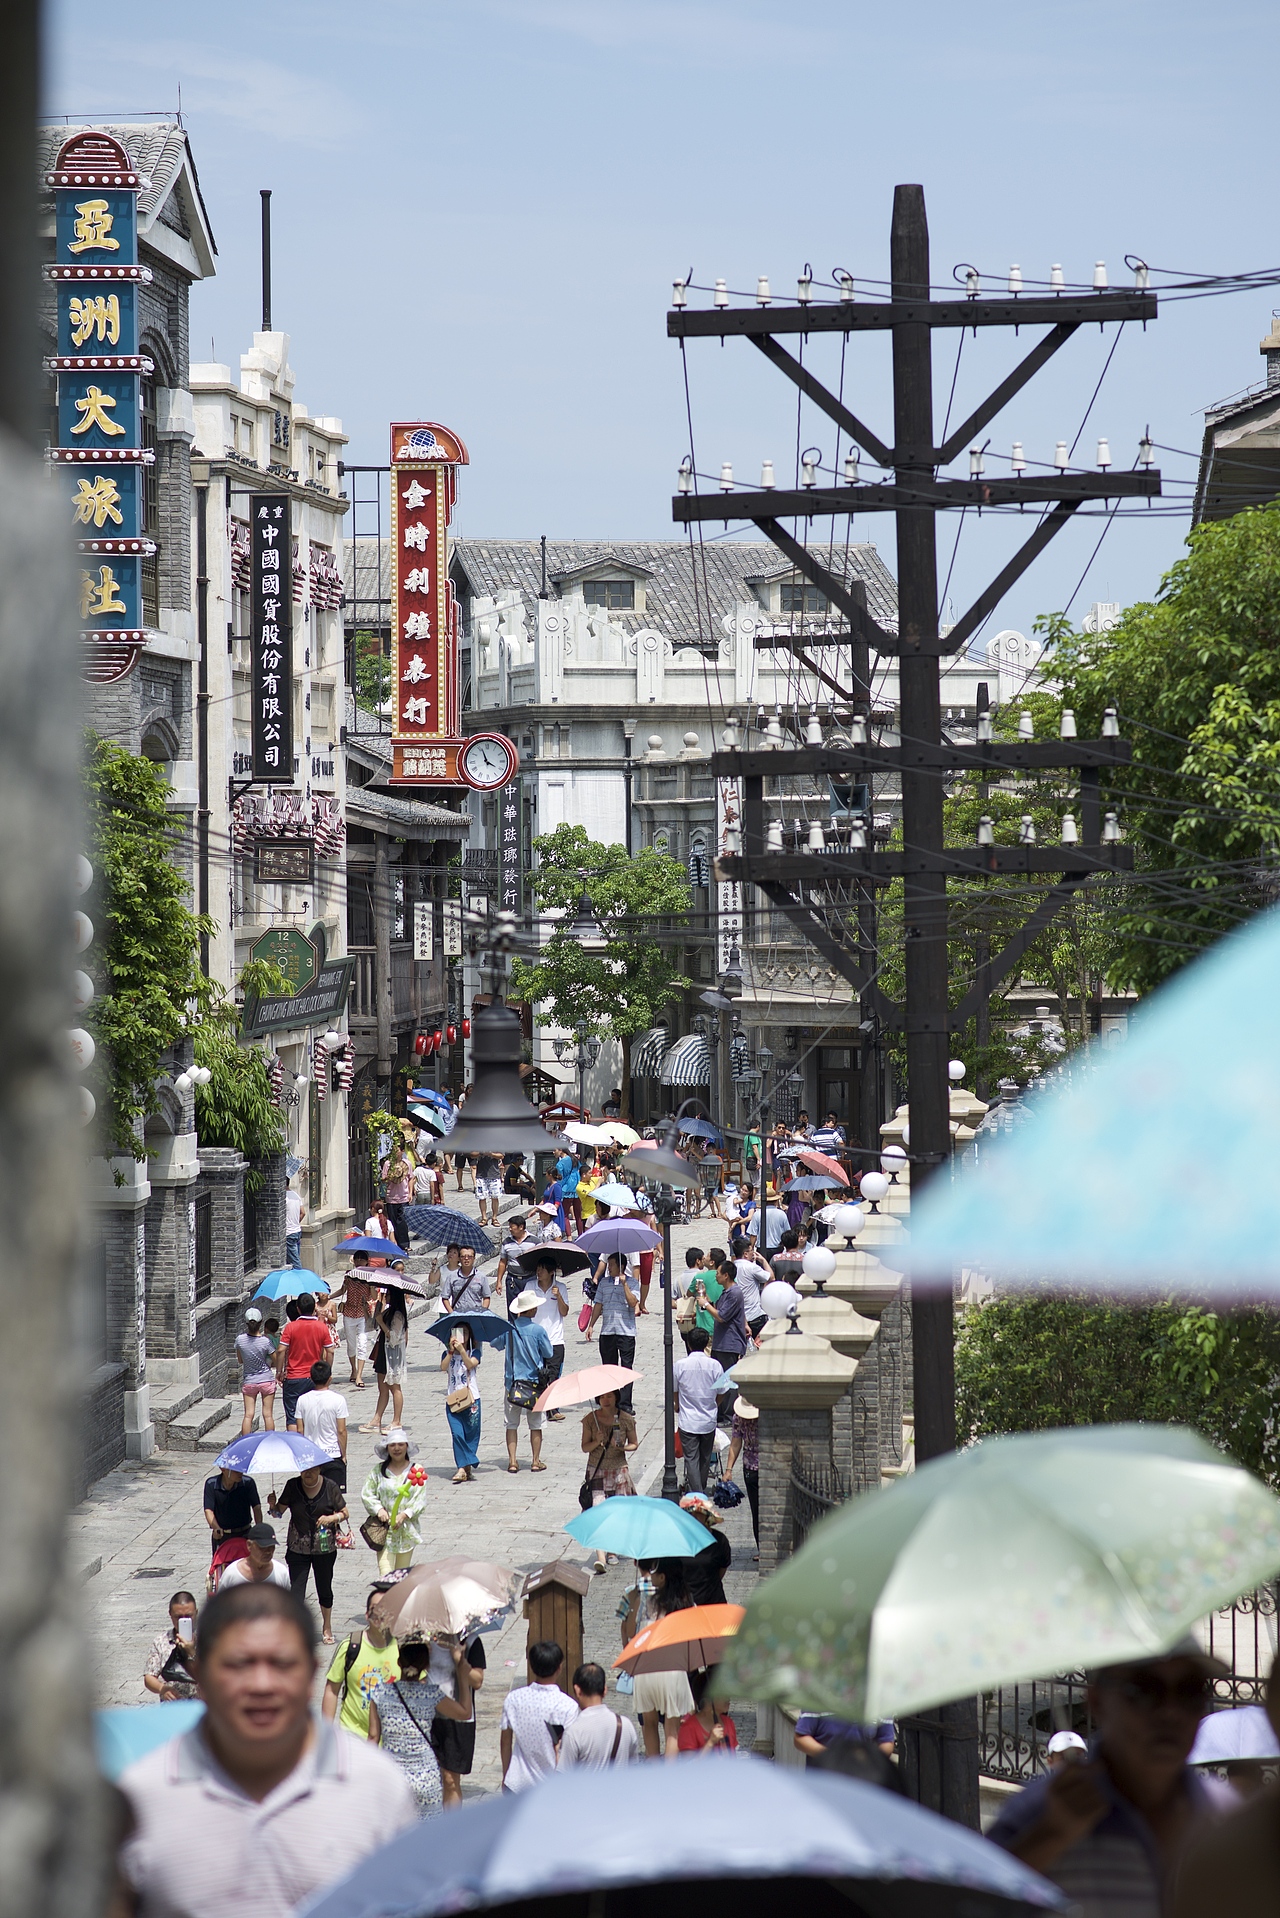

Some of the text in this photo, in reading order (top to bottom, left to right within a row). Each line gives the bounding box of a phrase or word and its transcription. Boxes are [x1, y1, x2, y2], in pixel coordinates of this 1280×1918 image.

[67, 199, 127, 619] 亞洲大旅社
[260, 524, 284, 767] 中國國貨股份有限公司
[503, 784, 519, 917] 中華琺瑯發行
[277, 932, 289, 940] 12
[306, 958, 313, 967] 3
